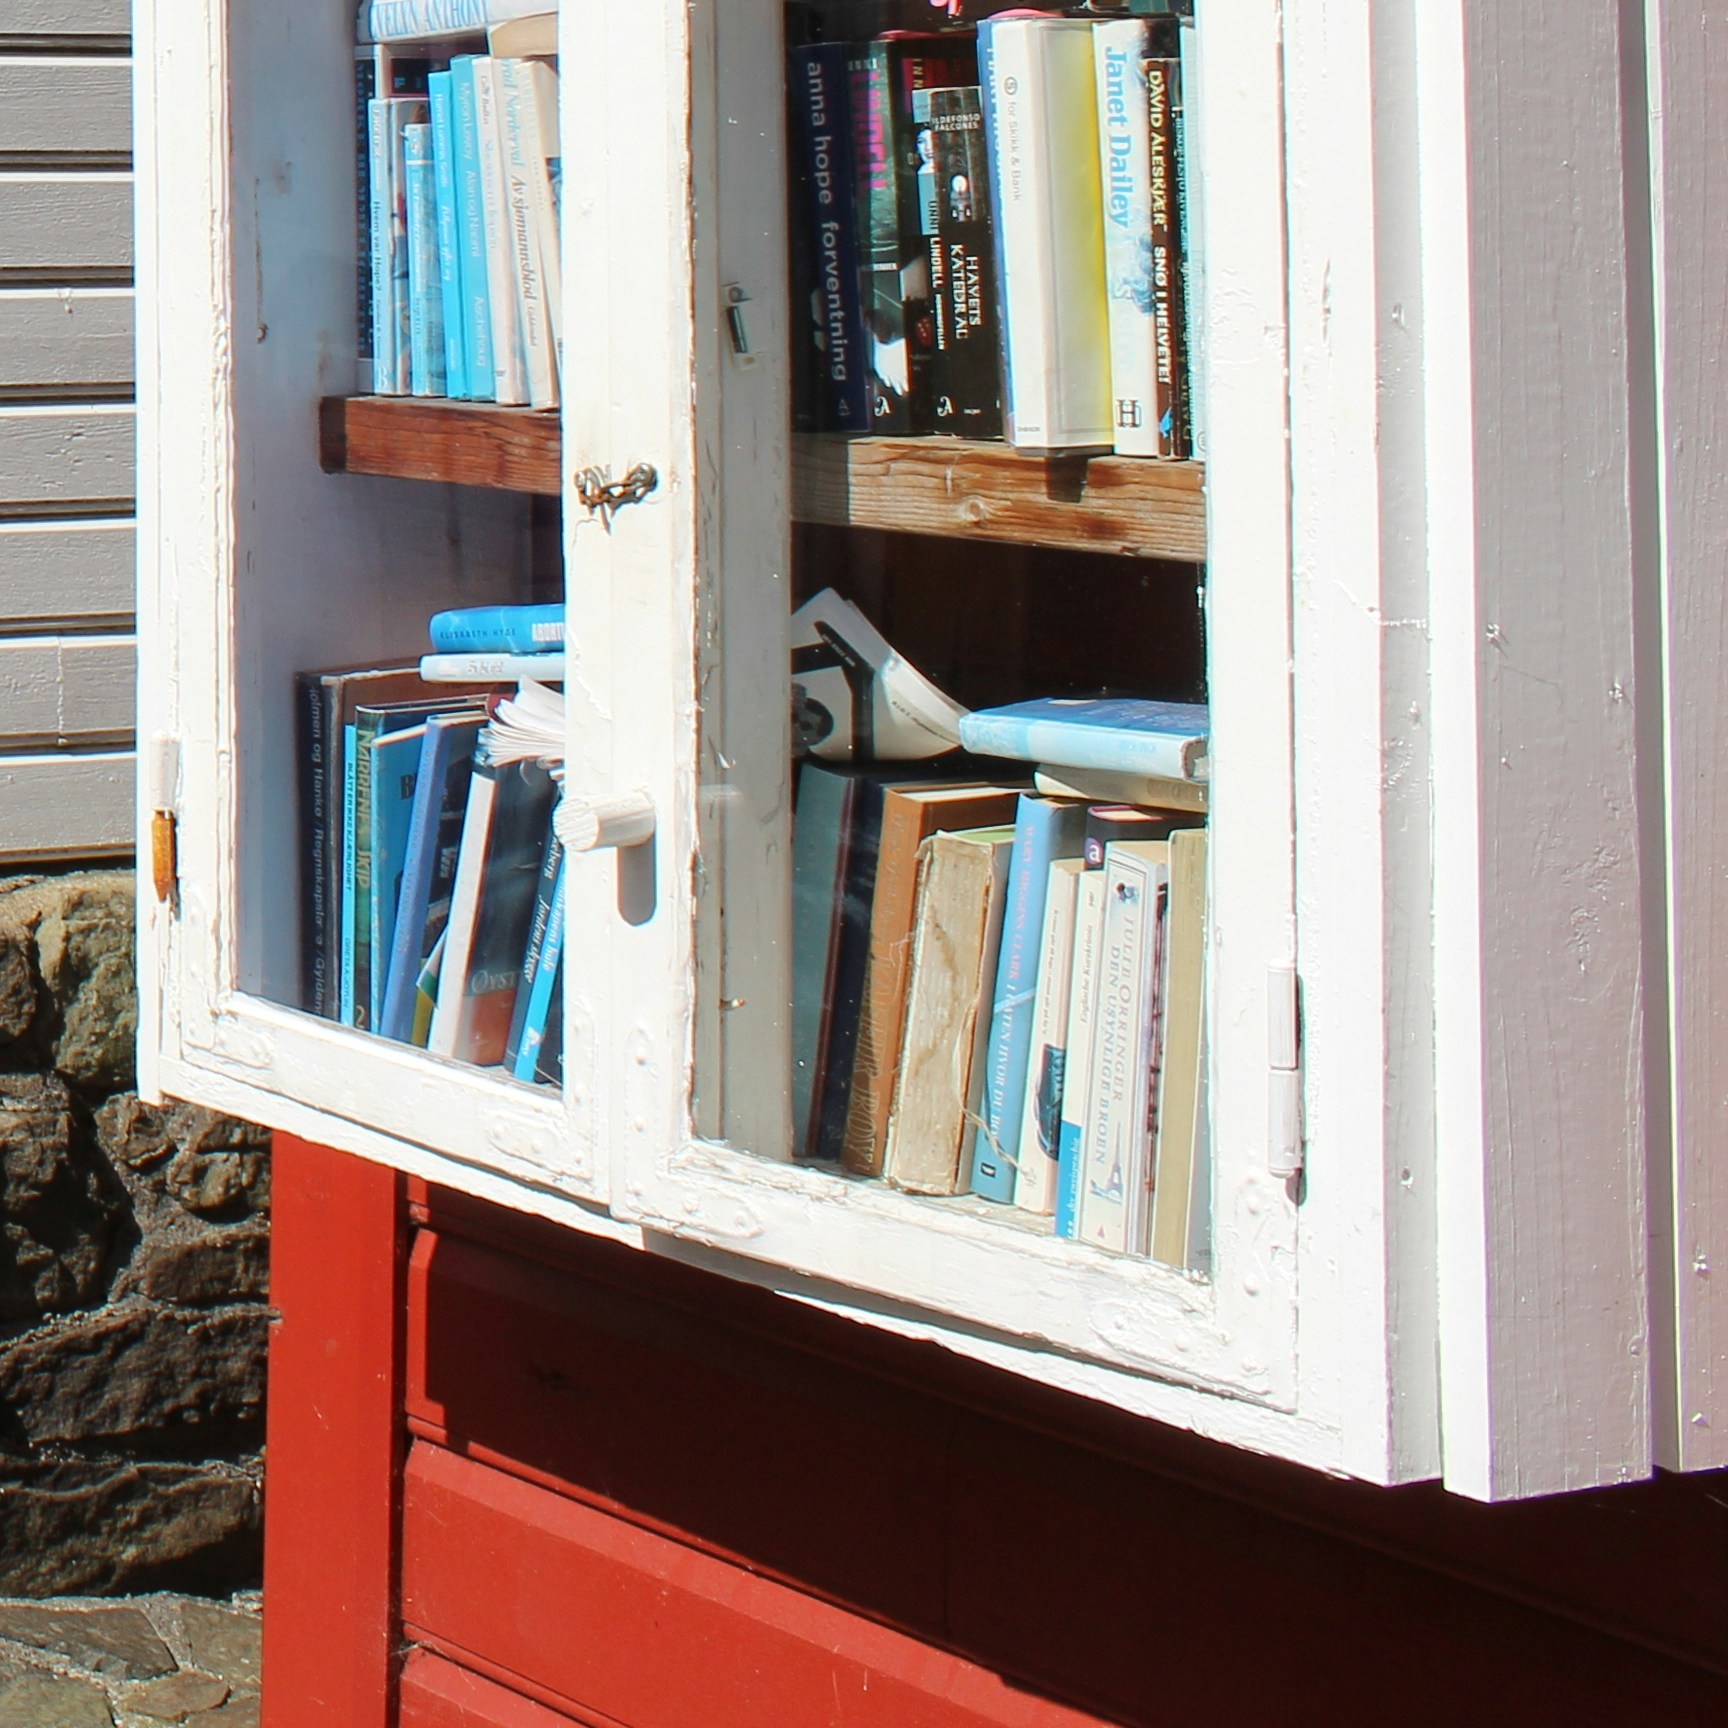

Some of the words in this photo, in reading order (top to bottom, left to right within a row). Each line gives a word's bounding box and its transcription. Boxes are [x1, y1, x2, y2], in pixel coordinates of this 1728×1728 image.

[457, 81, 473, 120] Myron
[804, 60, 829, 127] anna
[1103, 44, 1131, 128] Janet
[1146, 70, 1164, 126] DAVID
[460, 121, 475, 160] Levoy
[464, 169, 478, 198] Alan
[510, 174, 527, 196] Av
[809, 134, 838, 205] hope
[1009, 169, 1023, 202] Bank
[1105, 133, 1135, 229] Dailey
[372, 199, 382, 230] Hvem
[465, 199, 477, 216] og
[372, 233, 382, 253] var
[467, 217, 483, 257] Naomi
[512, 196, 536, 300] sjømannsblod
[928, 236, 944, 287] LINDELL
[372, 255, 384, 292] Hope?
[1152, 245, 1167, 284] SNØ
[817, 219, 852, 383] forventning
[947, 242, 970, 340] KATEDRAL
[963, 254, 982, 326] HAVETS
[470, 295, 489, 367] Aschehoug
[1154, 301, 1171, 384] HELVETE!
[307, 743, 319, 763] og
[527, 894, 552, 943] Jordens
[540, 944, 559, 973] hule
[1106, 944, 1121, 988] DEN
[1116, 916, 1136, 979] JULIE
[992, 1042, 1012, 1087] HVOR
[1098, 993, 1118, 1092] USYNLIGE
[1108, 982, 1132, 1102] ORRINGER
[989, 1088, 1006, 1113] DU
[1093, 1096, 1111, 1165] BROEN
